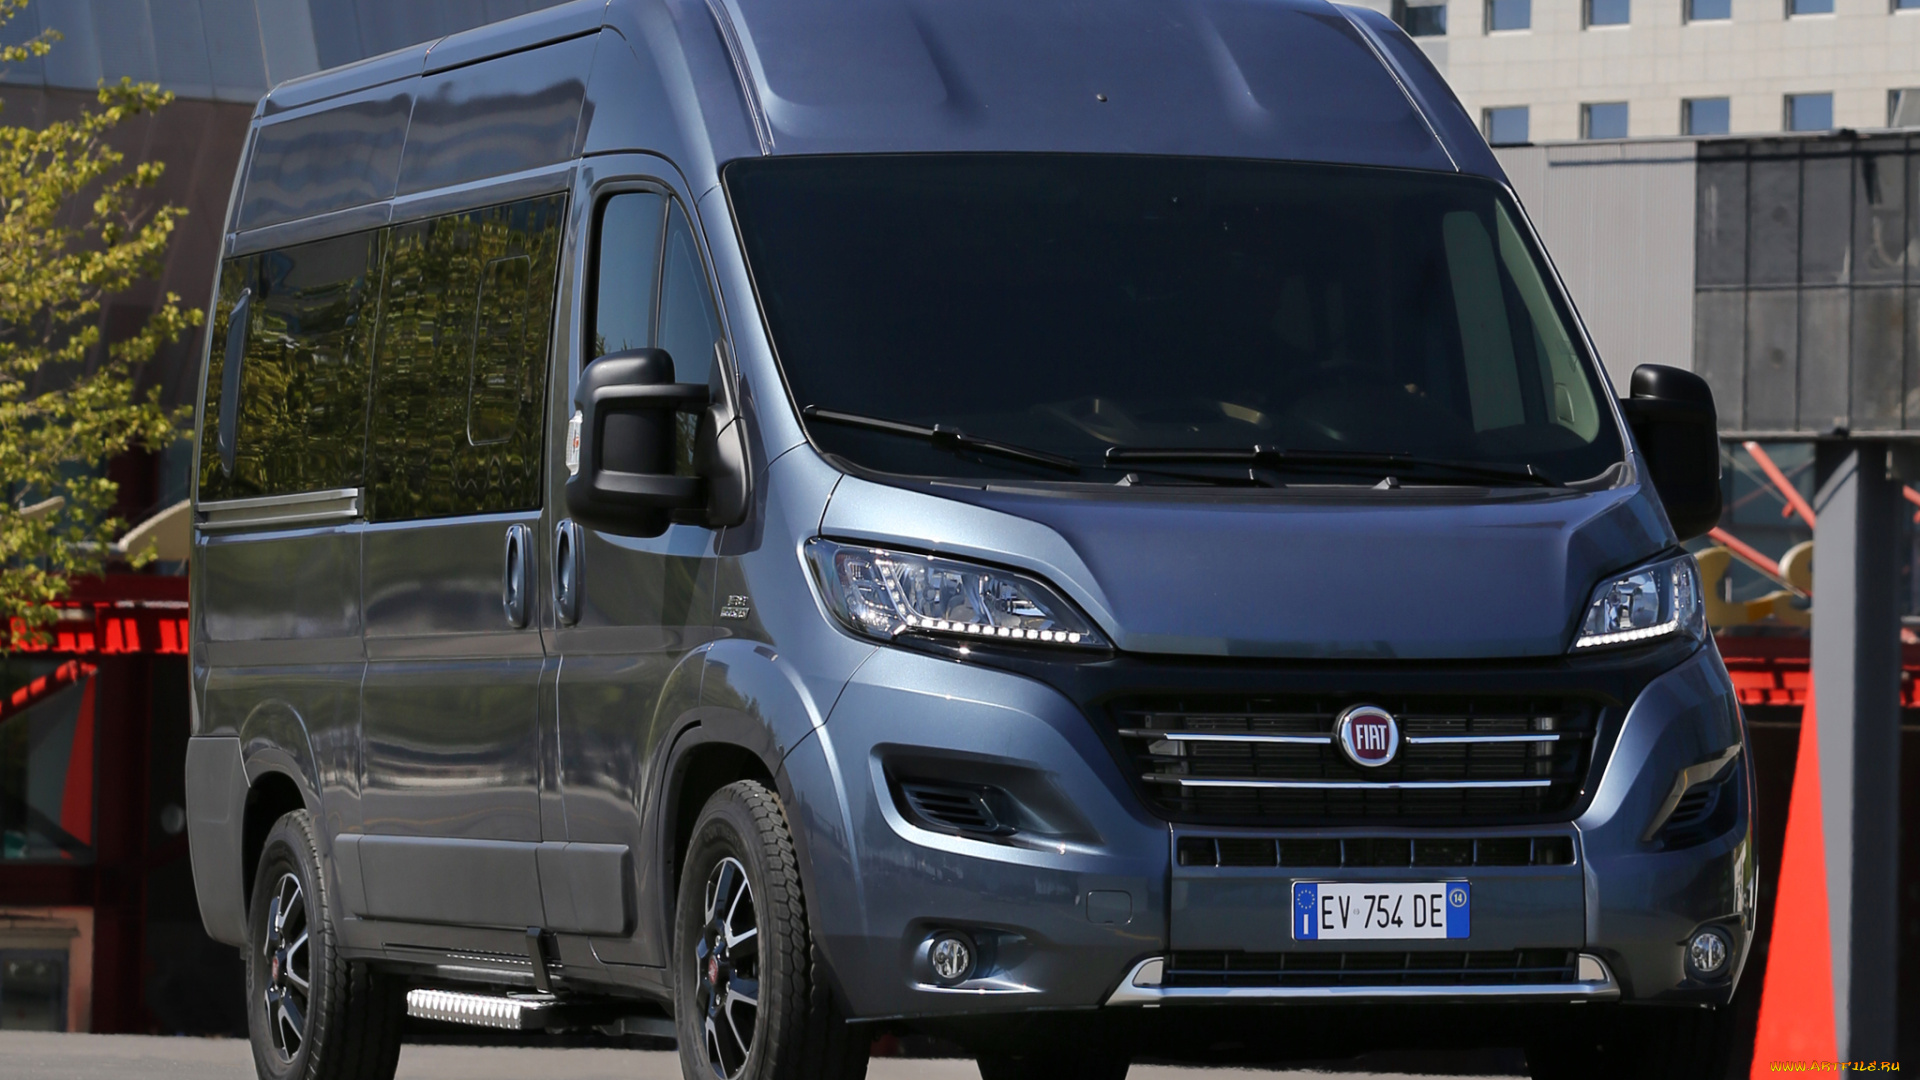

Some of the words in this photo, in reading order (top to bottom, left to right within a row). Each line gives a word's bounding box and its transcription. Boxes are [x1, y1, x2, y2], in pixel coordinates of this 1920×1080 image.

[1355, 724, 1387, 750] FIAT
[1321, 895, 1350, 929] EV
[1364, 894, 1403, 929] 754
[1413, 894, 1443, 929] DE
